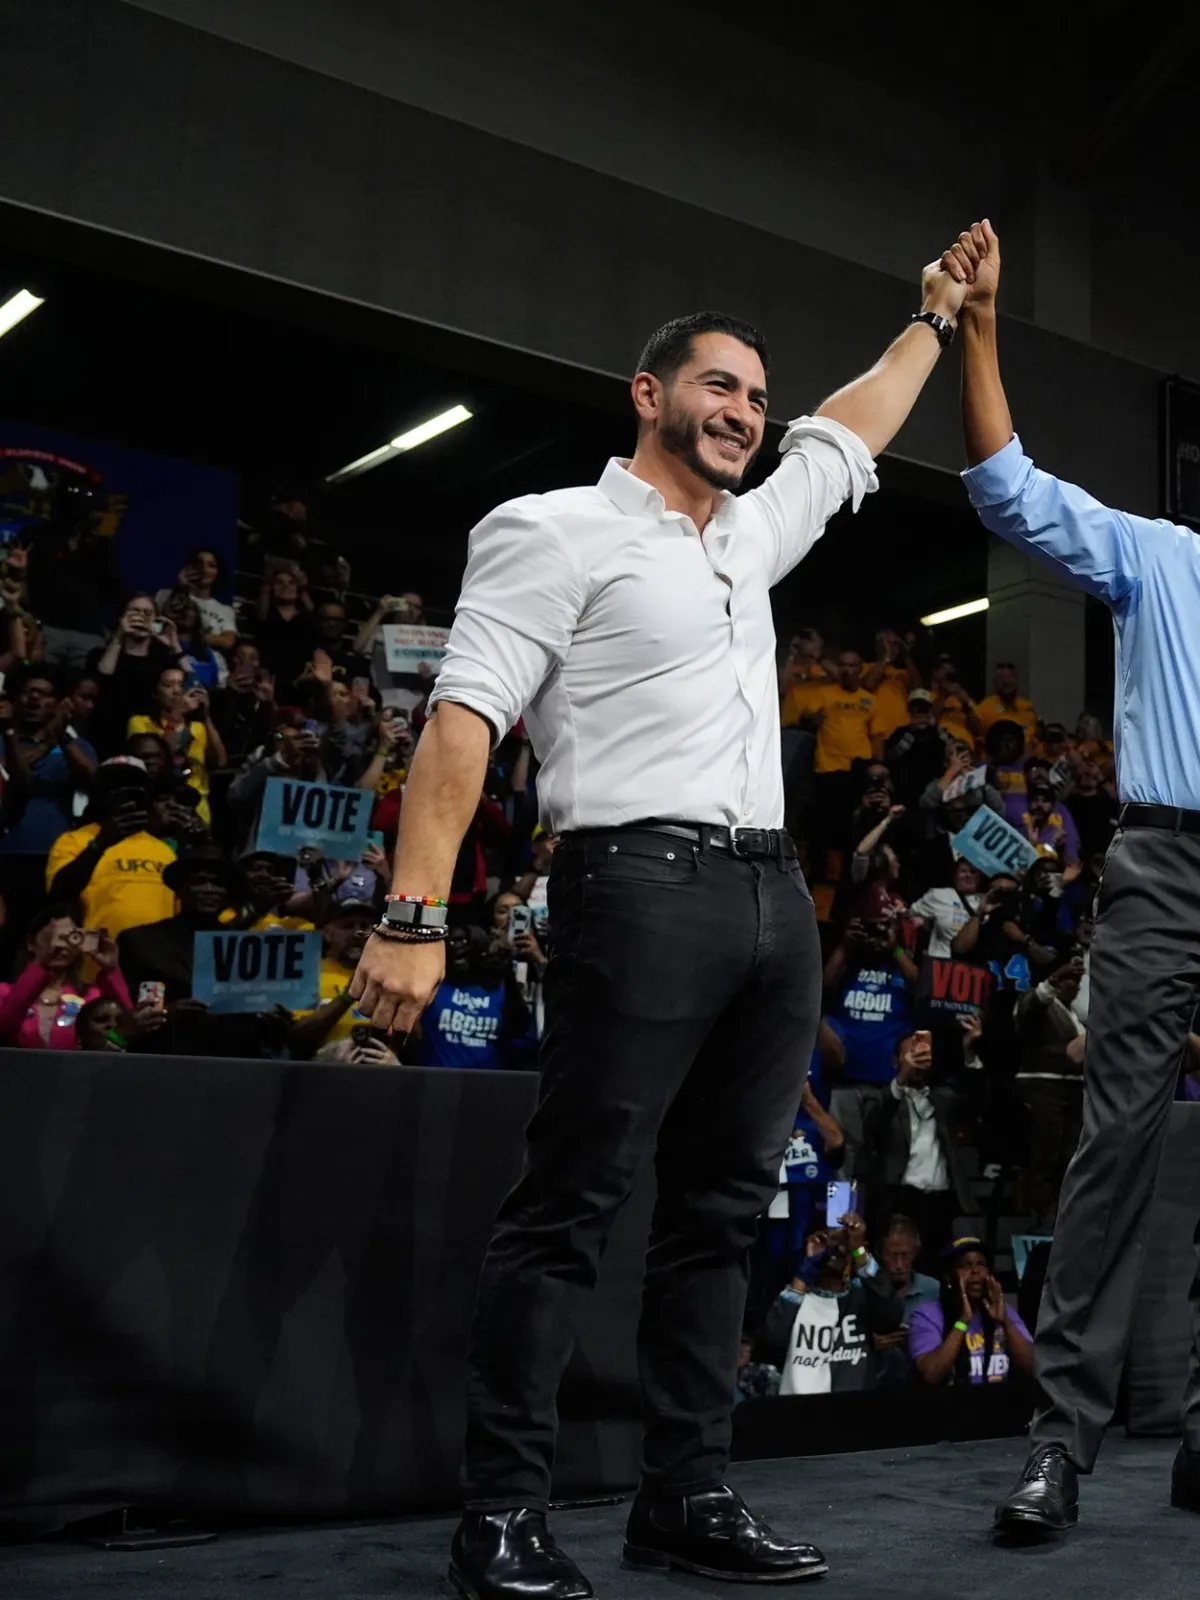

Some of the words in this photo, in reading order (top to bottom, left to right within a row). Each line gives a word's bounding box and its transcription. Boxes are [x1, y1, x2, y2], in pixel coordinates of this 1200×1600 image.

[282, 783, 362, 832] VOTE
[972, 814, 1028, 870] VOTE
[213, 934, 305, 982] VOTE
[437, 1007, 499, 1040] ABDUL
[843, 989, 893, 1013] ABDUL
